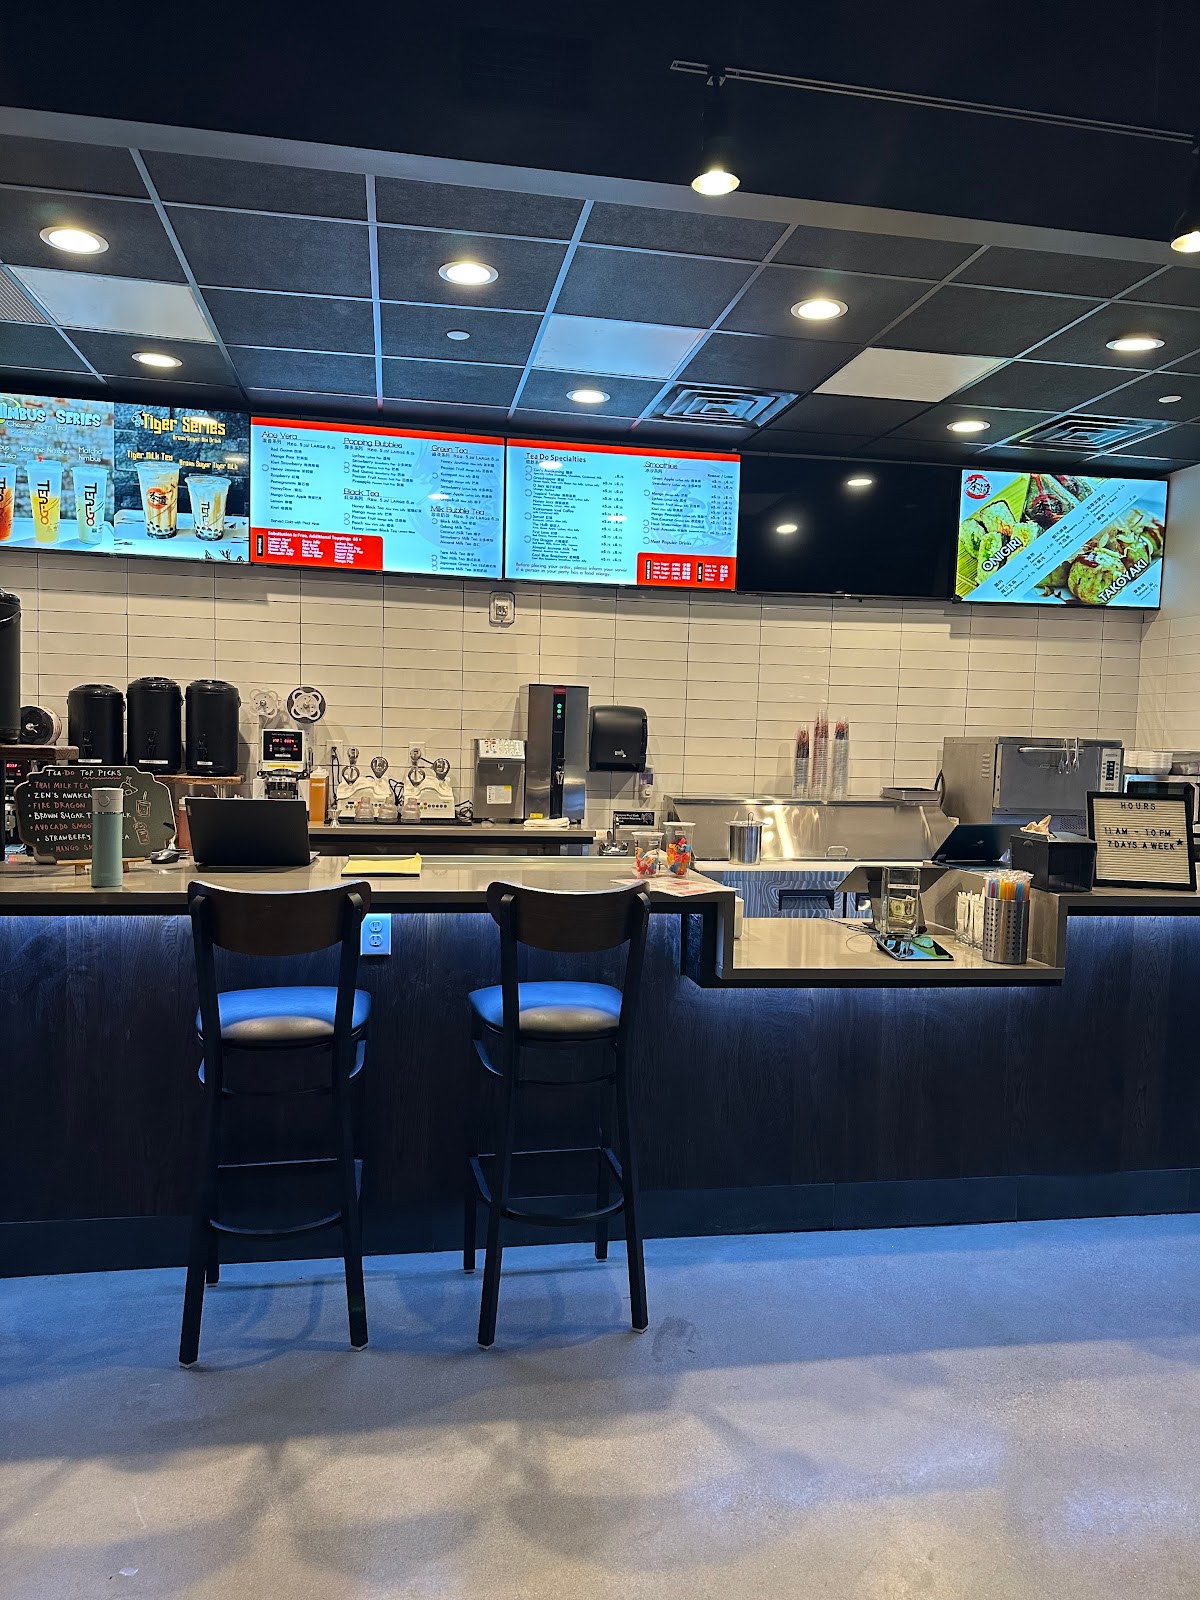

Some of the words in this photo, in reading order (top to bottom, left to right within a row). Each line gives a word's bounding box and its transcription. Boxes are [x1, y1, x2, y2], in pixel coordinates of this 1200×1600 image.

[56, 409, 102, 427] SERIES
[7, 420, 32, 429] Cheese
[142, 413, 178, 434] Tiger
[183, 416, 226, 436] Series
[280, 432, 298, 440] Vera
[344, 438, 373, 448] Popping
[375, 440, 402, 449] Bubbles
[20, 444, 45, 453] Jasmine
[47, 447, 70, 456] Nimbus
[78, 446, 103, 455] Matcha
[431, 444, 452, 453] Green
[455, 446, 468, 454] Tea
[78, 454, 102, 463] Nimbus
[128, 450, 144, 460] Tiger
[161, 452, 173, 462] Tea
[645, 461, 678, 470] Smoothies
[344, 488, 364, 496] Black
[366, 489, 380, 497] Tea
[430, 505, 445, 513] Milk
[446, 506, 469, 514] Bubble
[472, 508, 484, 516] Tea
[983, 537, 1023, 571] ONIGIRI
[1098, 558, 1148, 602] TAKOYAKI
[98, 769, 122, 777] PICKS
[54, 781, 72, 789] MILK
[33, 801, 51, 809] FIRE
[54, 801, 86, 809] DRAGON
[1120, 802, 1156, 810] HOURS
[34, 811, 58, 819] BROWN
[60, 811, 85, 819] SUGAR
[34, 823, 68, 831] AVOCADO
[1145, 828, 1156, 836] 10
[1159, 829, 1171, 837] PM
[44, 834, 91, 842] STRAWBERRY
[56, 845, 80, 853] MANGO
[1115, 841, 1138, 849] DAYS
[1151, 842, 1175, 850] WEEK
